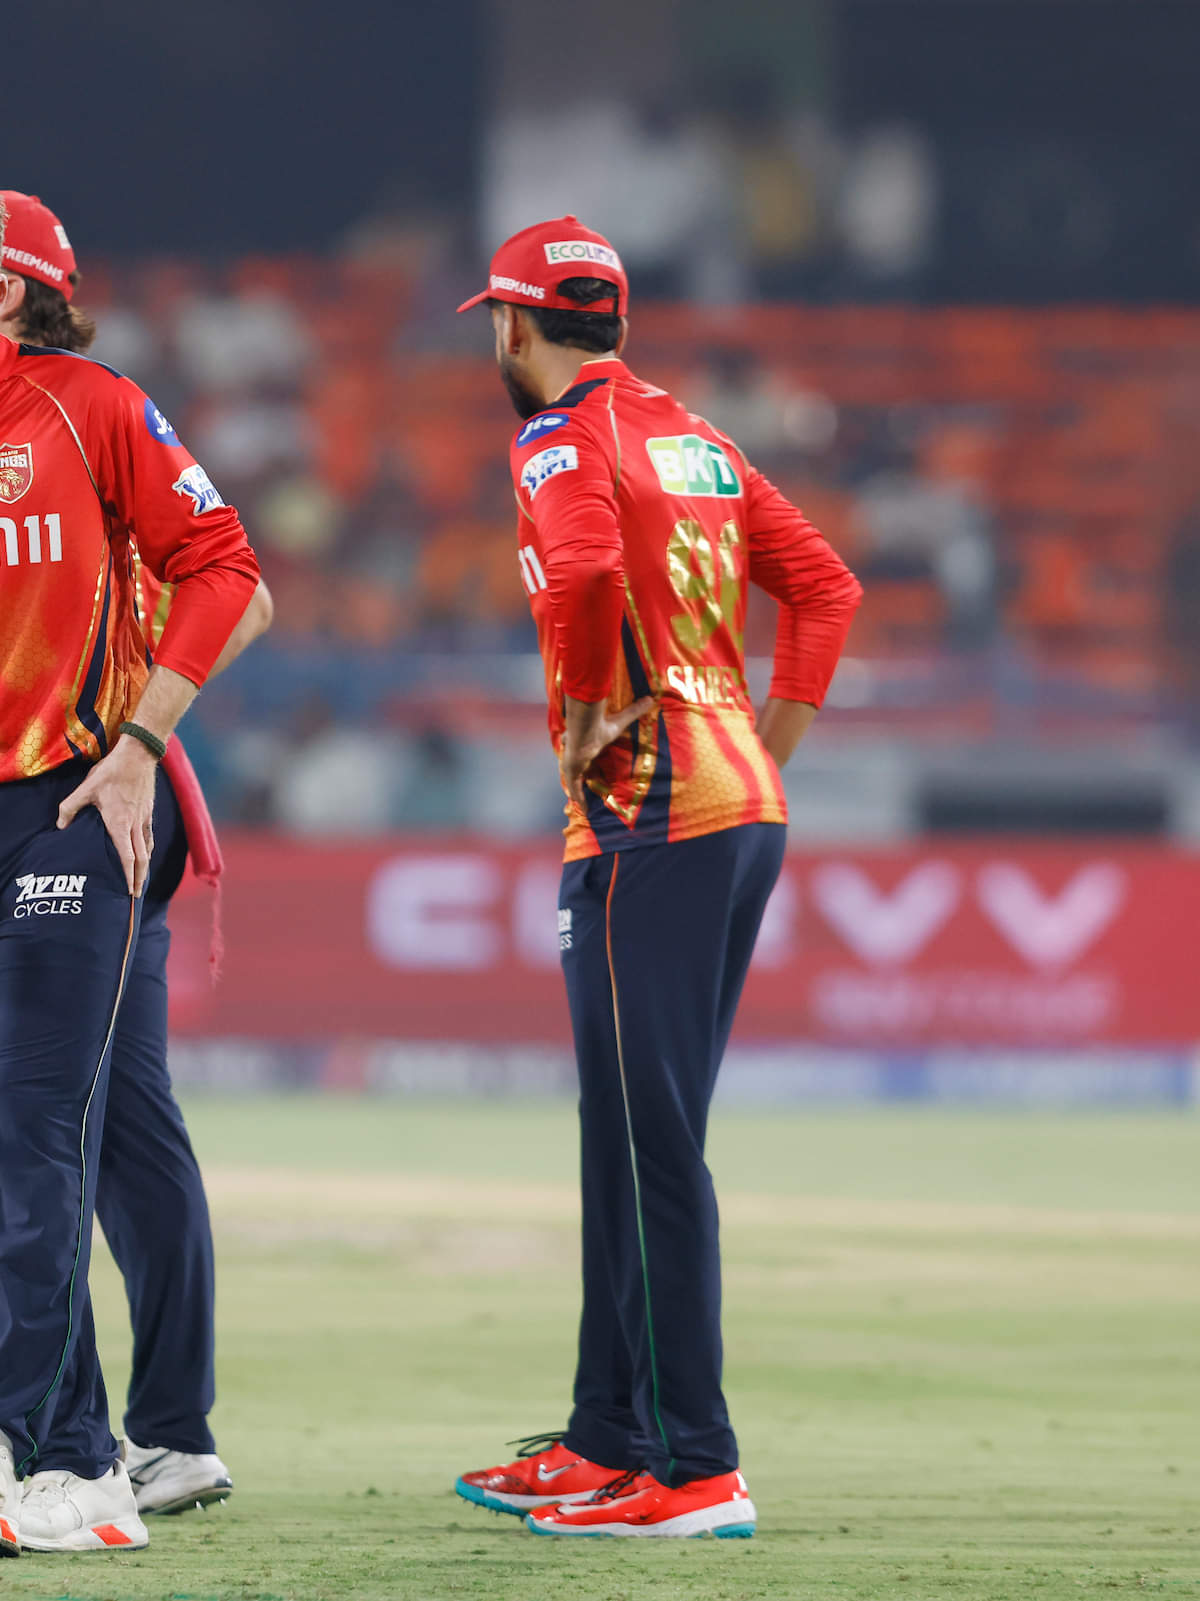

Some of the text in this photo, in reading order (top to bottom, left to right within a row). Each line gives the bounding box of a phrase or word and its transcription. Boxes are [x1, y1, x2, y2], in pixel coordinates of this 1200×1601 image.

[517, 416, 564, 442] Jio
[653, 444, 735, 484] BKT
[16, 873, 87, 903] AVON
[13, 900, 83, 919] CYCLES
